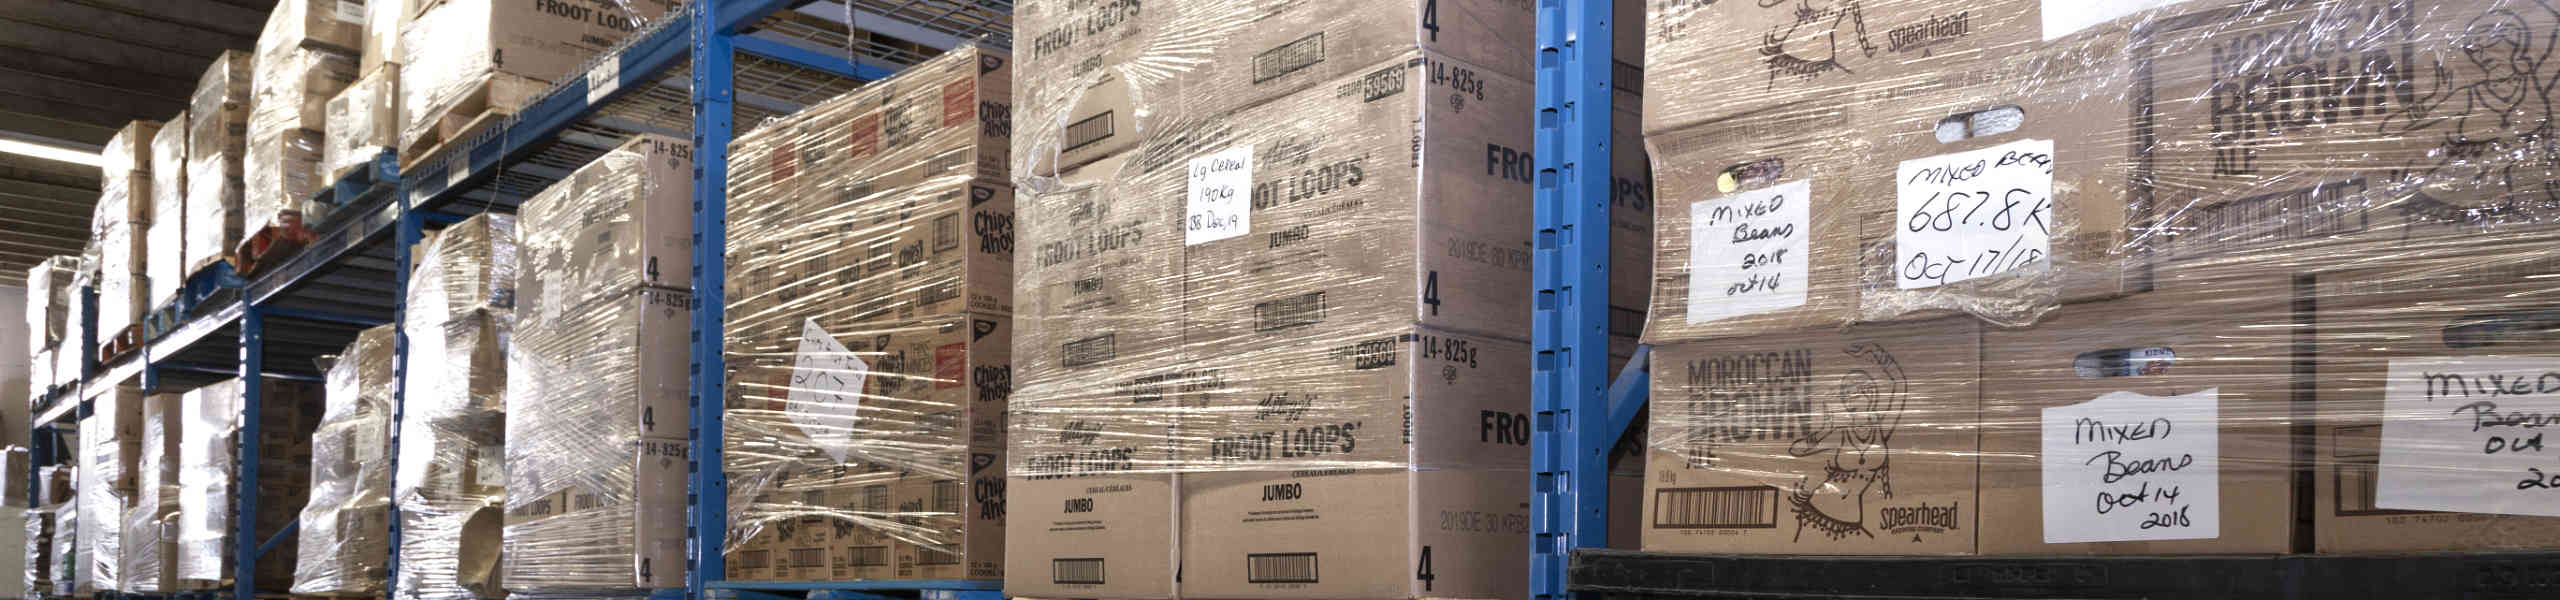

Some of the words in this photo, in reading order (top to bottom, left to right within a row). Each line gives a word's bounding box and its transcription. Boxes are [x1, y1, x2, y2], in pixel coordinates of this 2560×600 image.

[536, 0, 592, 23] FROOT
[492, 48, 504, 68] 4
[1365, 68, 1404, 100] 59569
[2211, 44, 2415, 142] BROWN
[1487, 143, 1534, 184] FRO
[1908, 159, 1987, 187] MIXED
[2212, 148, 2258, 179] ALE
[1709, 195, 1785, 226] MIXED
[1268, 224, 1310, 249] JUMBO
[1732, 223, 1794, 244] Beans
[646, 256, 660, 281] 4
[1423, 270, 1441, 317] 4
[1687, 349, 1813, 392] MOROCCAN
[2423, 371, 2560, 402] MIXED
[643, 405, 656, 432] 4
[1479, 410, 1529, 446] FRO
[2075, 416, 2173, 444] MIXED
[2451, 400, 2560, 432] Bean
[1210, 430, 1275, 463] FROOT
[2085, 450, 2193, 484] Beans
[975, 476, 1006, 504] Chip
[1262, 482, 1303, 502] JUMBO
[2154, 485, 2181, 505] 14
[1063, 498, 1094, 514] JUMBO
[1880, 501, 1957, 530] spearhead
[640, 558, 653, 583] 4
[1416, 546, 1435, 592] 4
